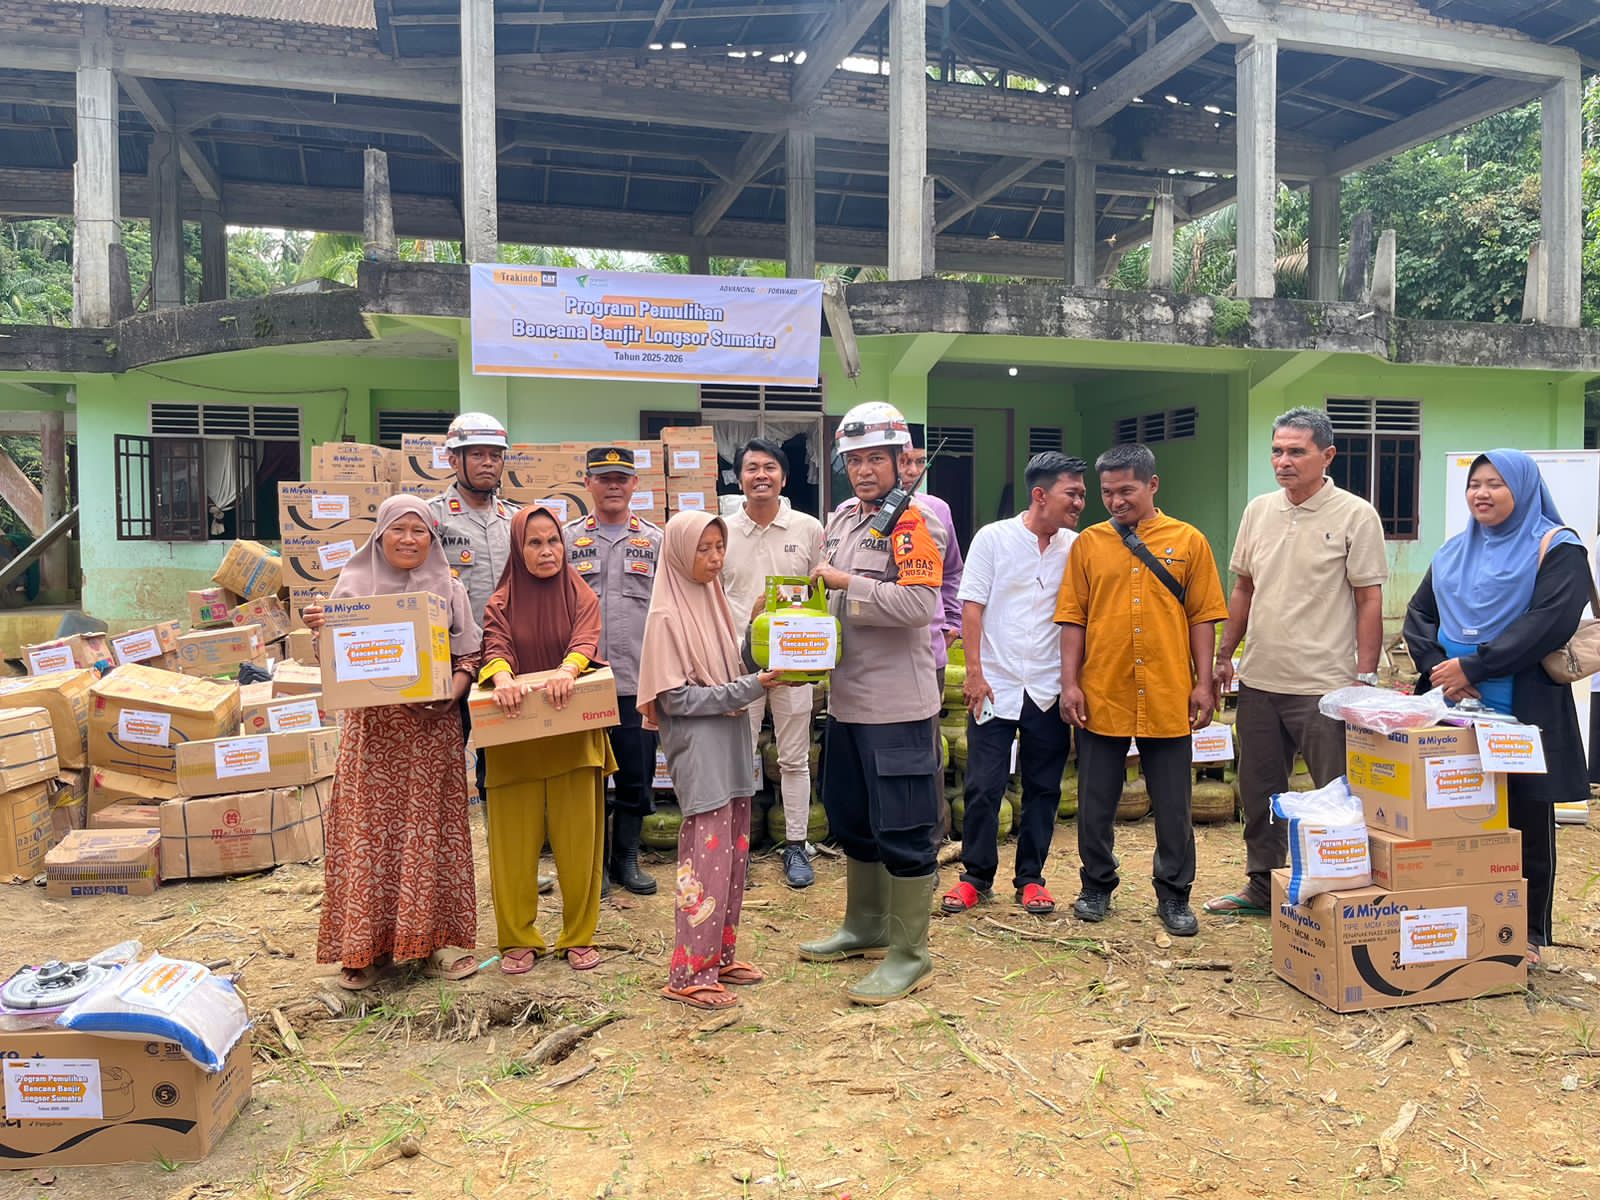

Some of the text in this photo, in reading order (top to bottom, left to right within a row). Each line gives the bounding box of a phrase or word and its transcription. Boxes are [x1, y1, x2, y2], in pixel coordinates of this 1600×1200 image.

[501, 272, 538, 283] Trakindo
[720, 285, 798, 295] ADVANCING FORWARD
[565, 296, 724, 321] Program Pemulihan
[512, 319, 776, 349] Bencana Banjir Longsor Sumatra
[614, 351, 684, 363] Tahun 2025-2026
[860, 539, 888, 551] POLRI
[572, 549, 597, 560] BAIM
[626, 548, 654, 560] POLRI
[898, 558, 934, 571] TIM GAS
[334, 602, 370, 613] Miyako
[582, 707, 616, 721] Rinnai
[1426, 735, 1458, 745] Miyako
[1490, 862, 1520, 873] Rinnai
[1357, 901, 1409, 920] Miyako
[1287, 906, 1321, 931] Miyako
[165, 1043, 182, 1052] SNI
